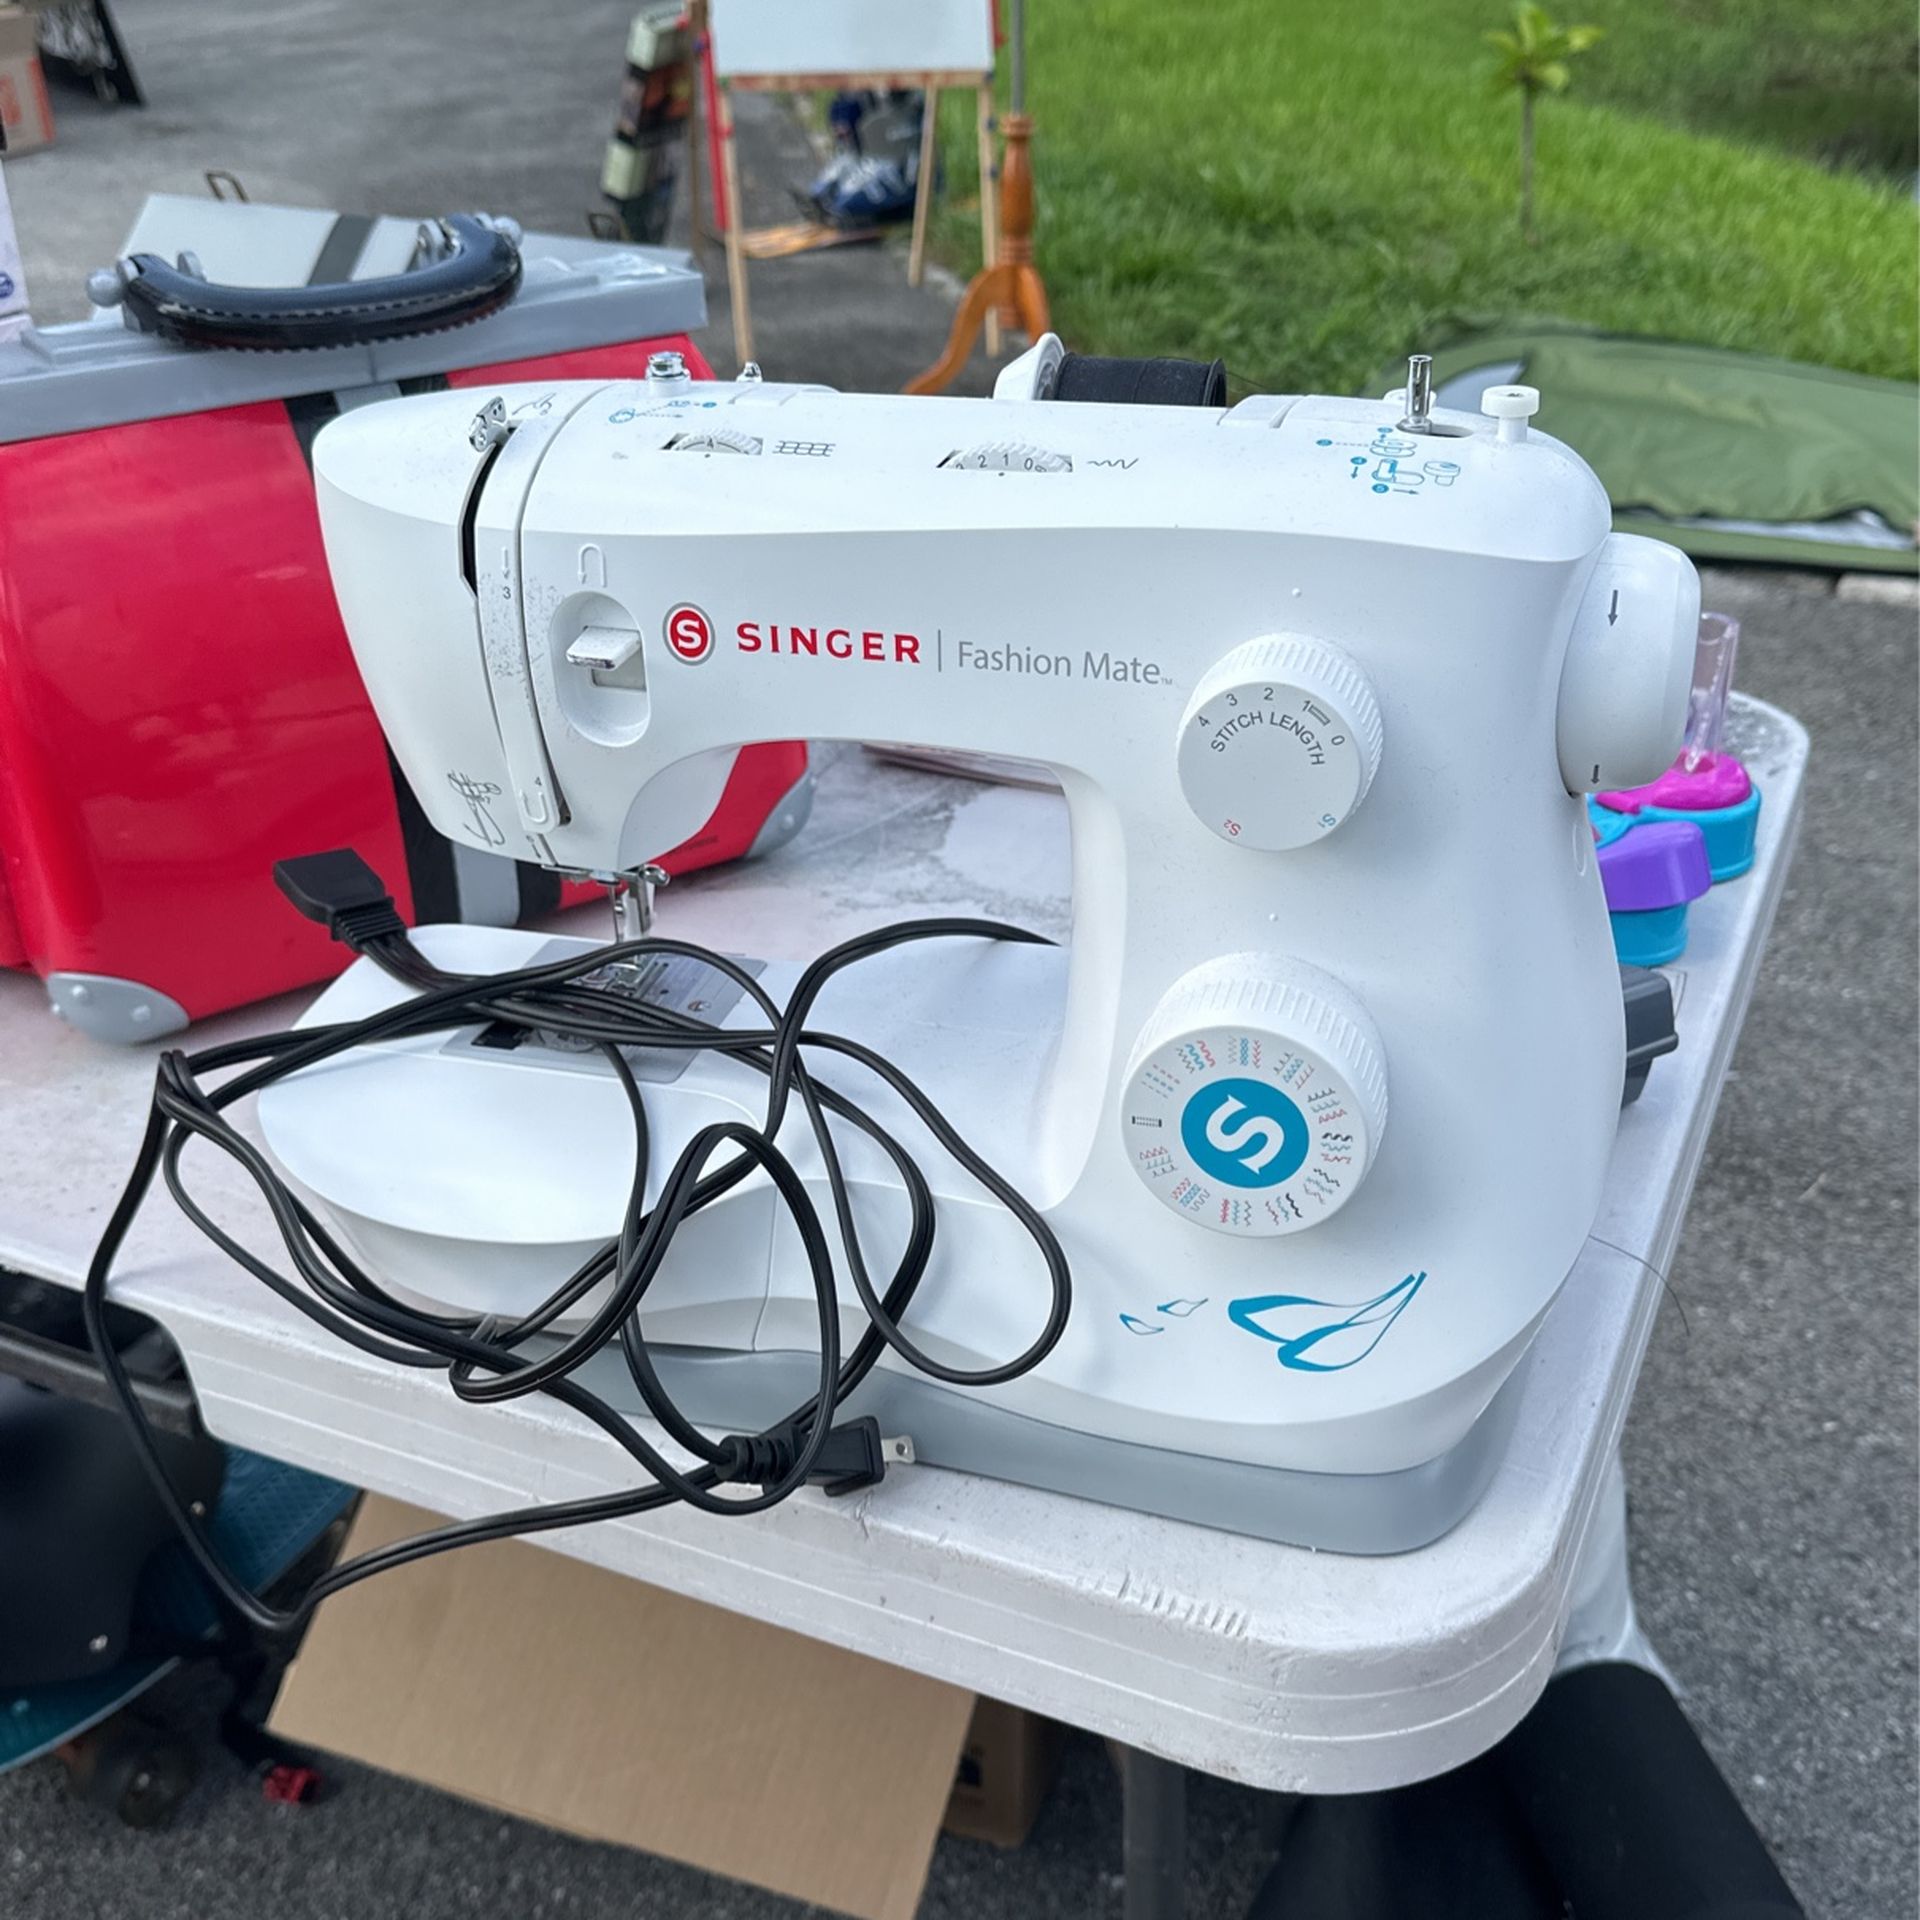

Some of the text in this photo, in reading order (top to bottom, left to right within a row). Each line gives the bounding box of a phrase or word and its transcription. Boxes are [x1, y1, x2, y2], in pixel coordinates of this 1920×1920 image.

[977, 454, 988, 468] 2
[1002, 453, 1009, 466] 1
[1024, 457, 1034, 471] 0
[503, 586, 512, 600] 3
[736, 622, 920, 664] SINGER
[958, 641, 1072, 677] Fashion
[1083, 651, 1160, 685] Mate
[1198, 687, 1345, 746] 4 3 2 1 0
[1210, 710, 1325, 765] STITCH LENGTH
[1206, 1094, 1285, 1175] S
